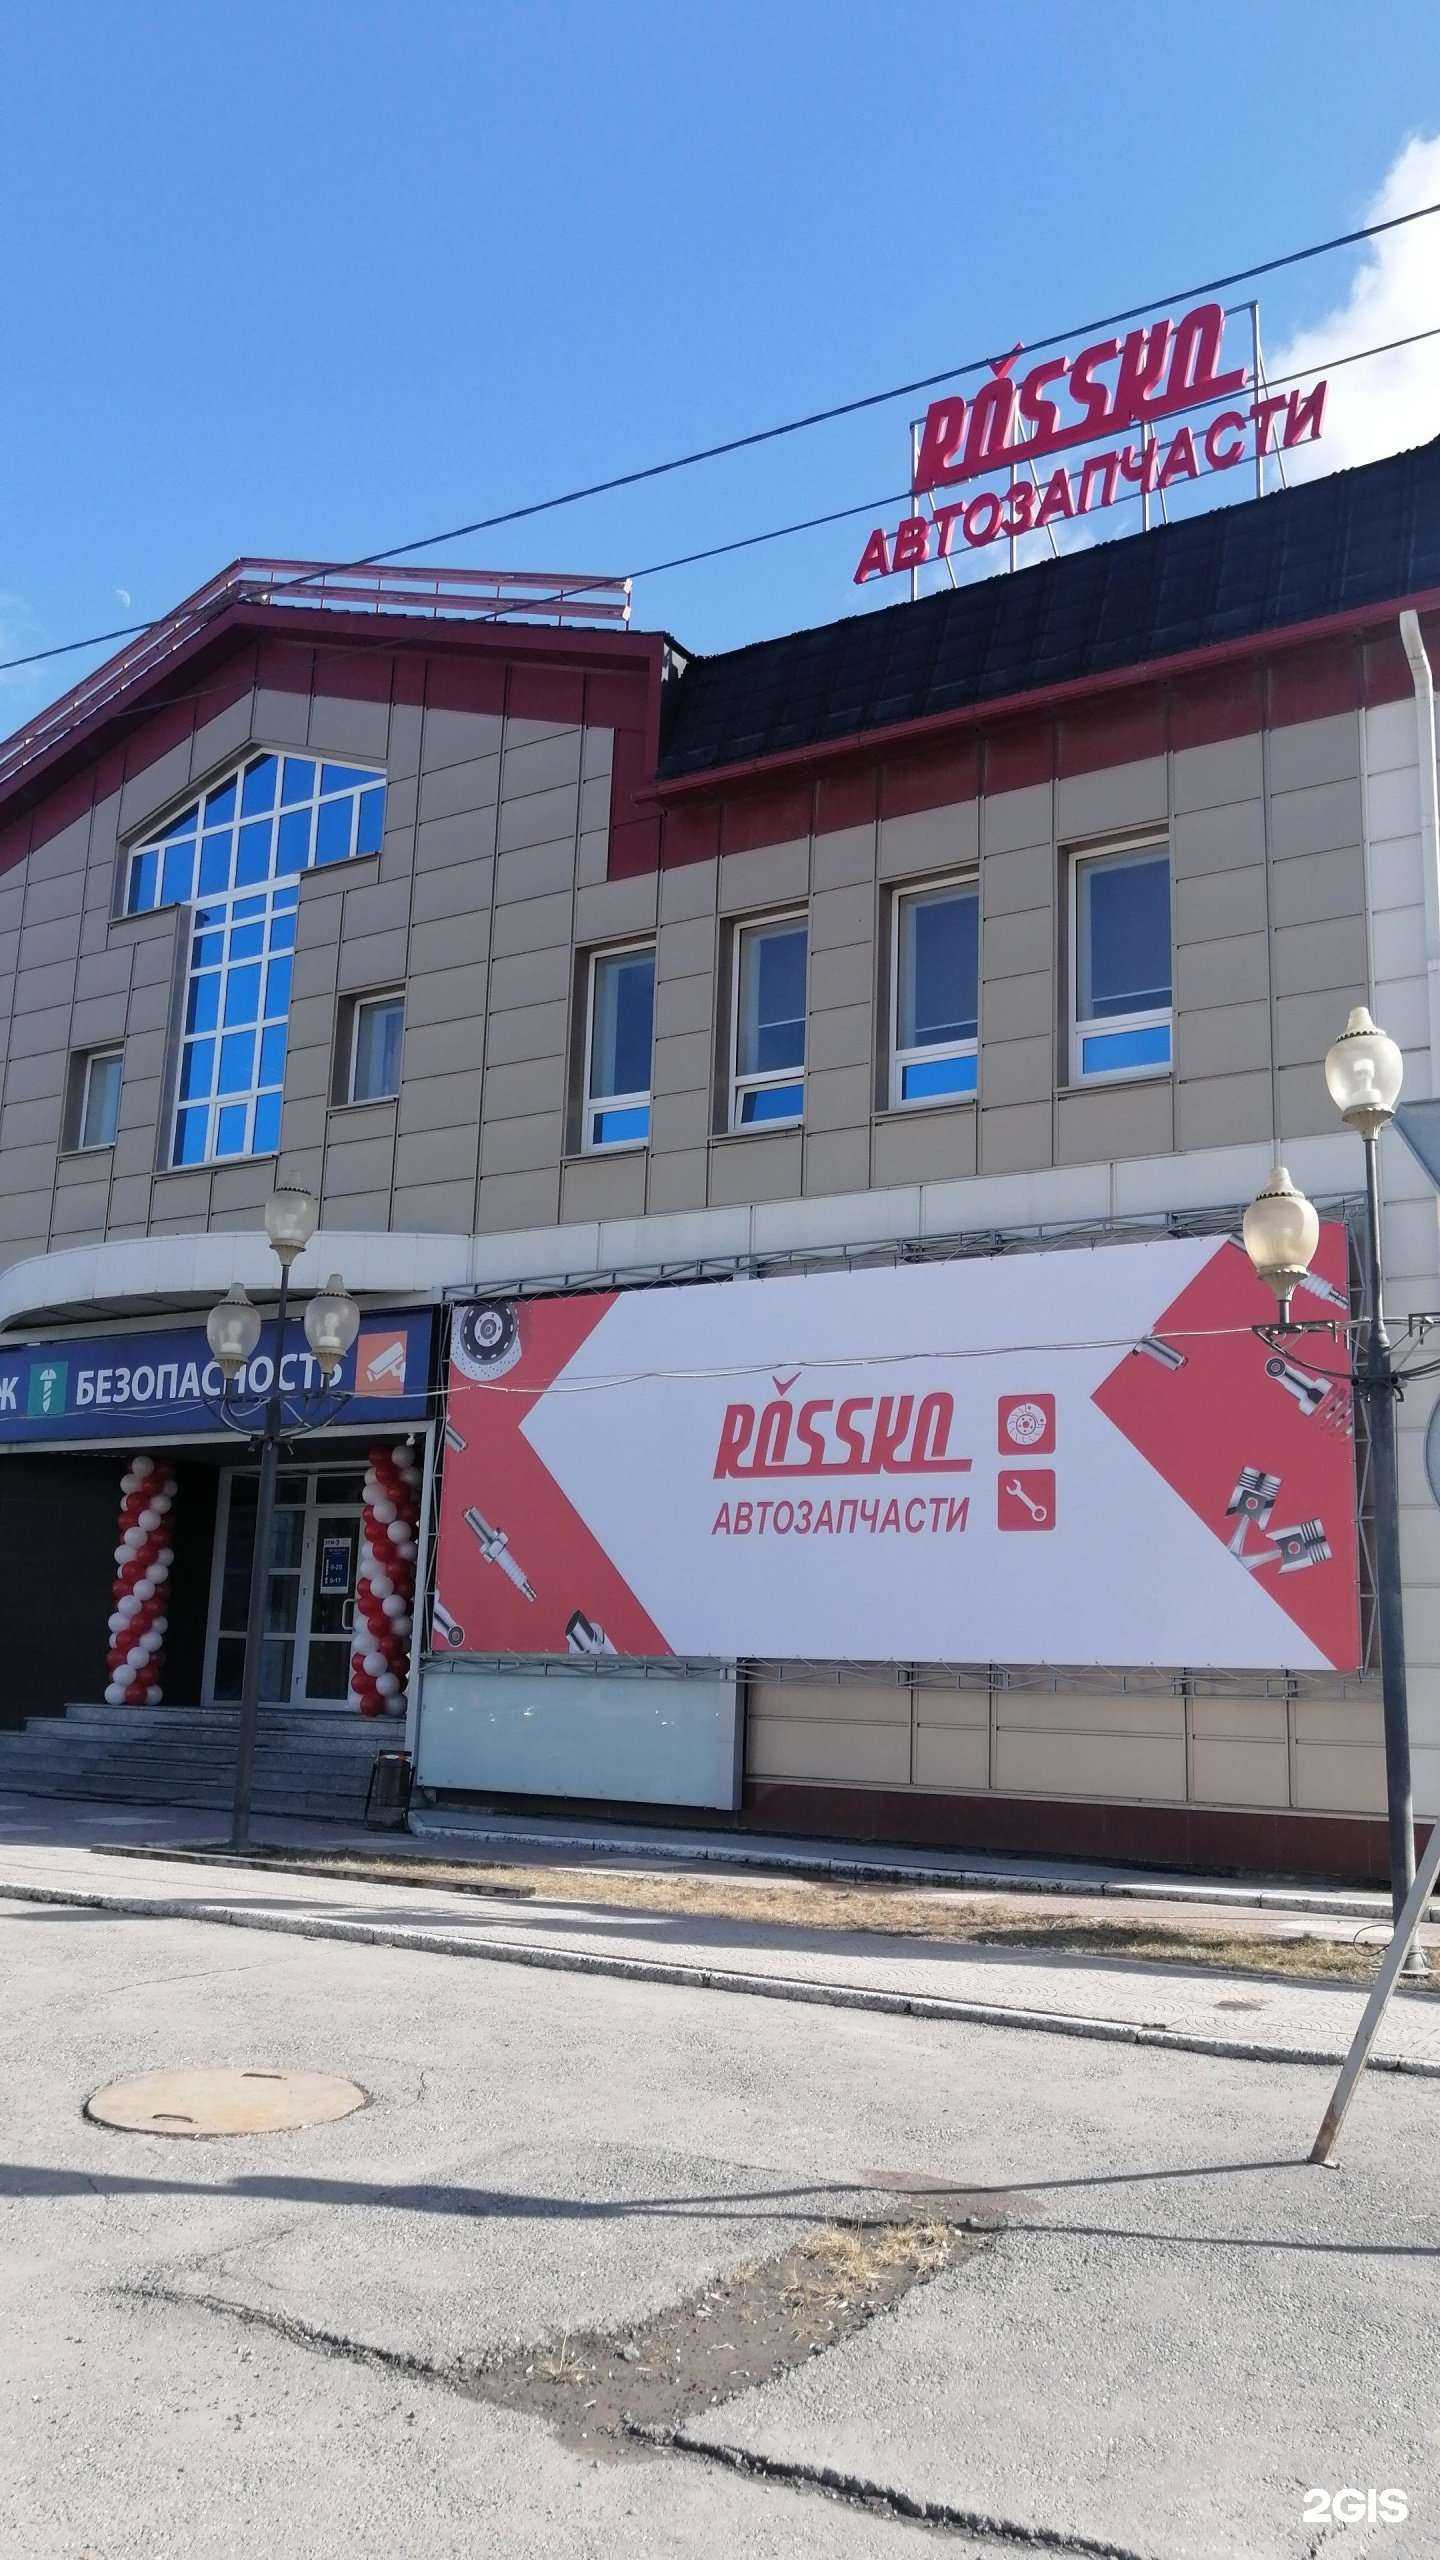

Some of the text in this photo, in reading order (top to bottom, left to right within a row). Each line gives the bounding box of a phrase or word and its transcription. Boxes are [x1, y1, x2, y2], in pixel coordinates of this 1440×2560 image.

[912, 303, 1247, 495] ROSSKO
[853, 380, 1328, 584] АВТОЗАПЧАСТИ
[713, 1371, 973, 1480] ROSSKO
[711, 1496, 971, 1535] АВТОЗАПЧАСТИ
